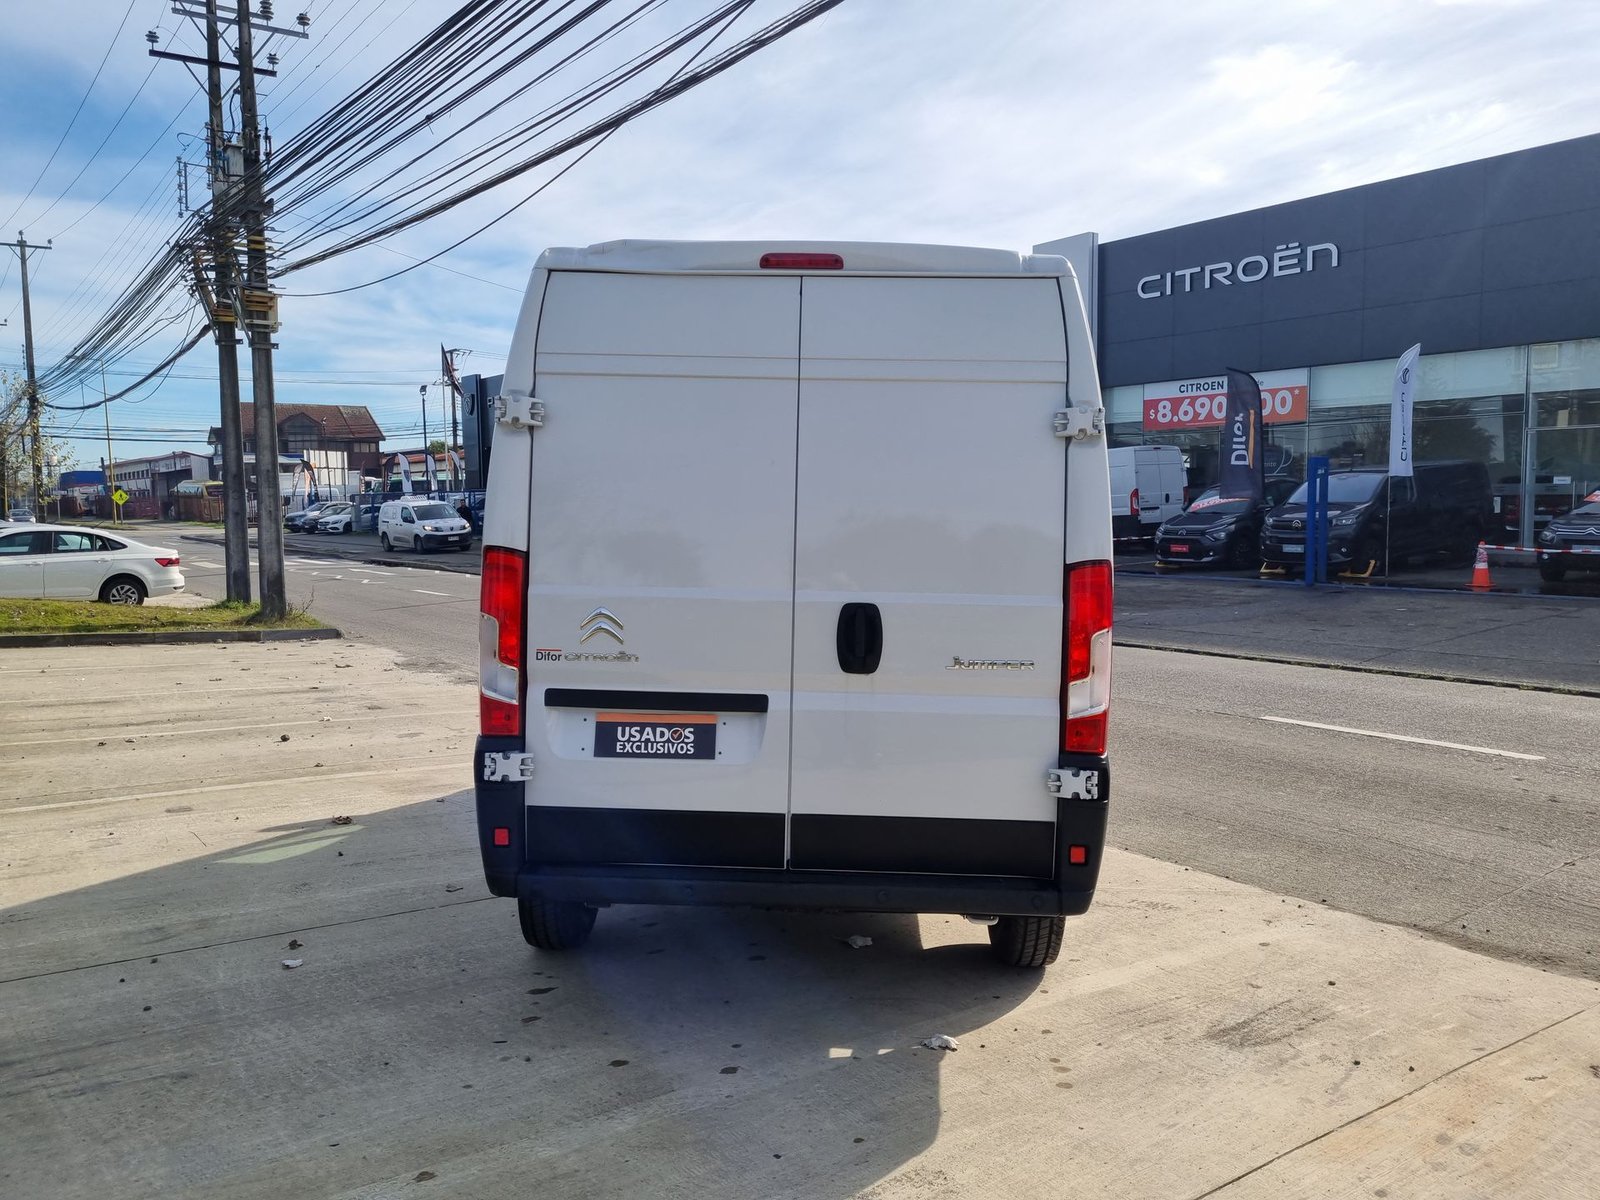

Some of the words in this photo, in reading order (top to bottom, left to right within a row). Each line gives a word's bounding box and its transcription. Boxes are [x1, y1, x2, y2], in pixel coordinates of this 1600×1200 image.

[1179, 381, 1224, 393] CITROEN
[535, 651, 562, 662] Difor
[616, 726, 695, 743] USADOS
[616, 742, 695, 754] EXCLUSIVOS
